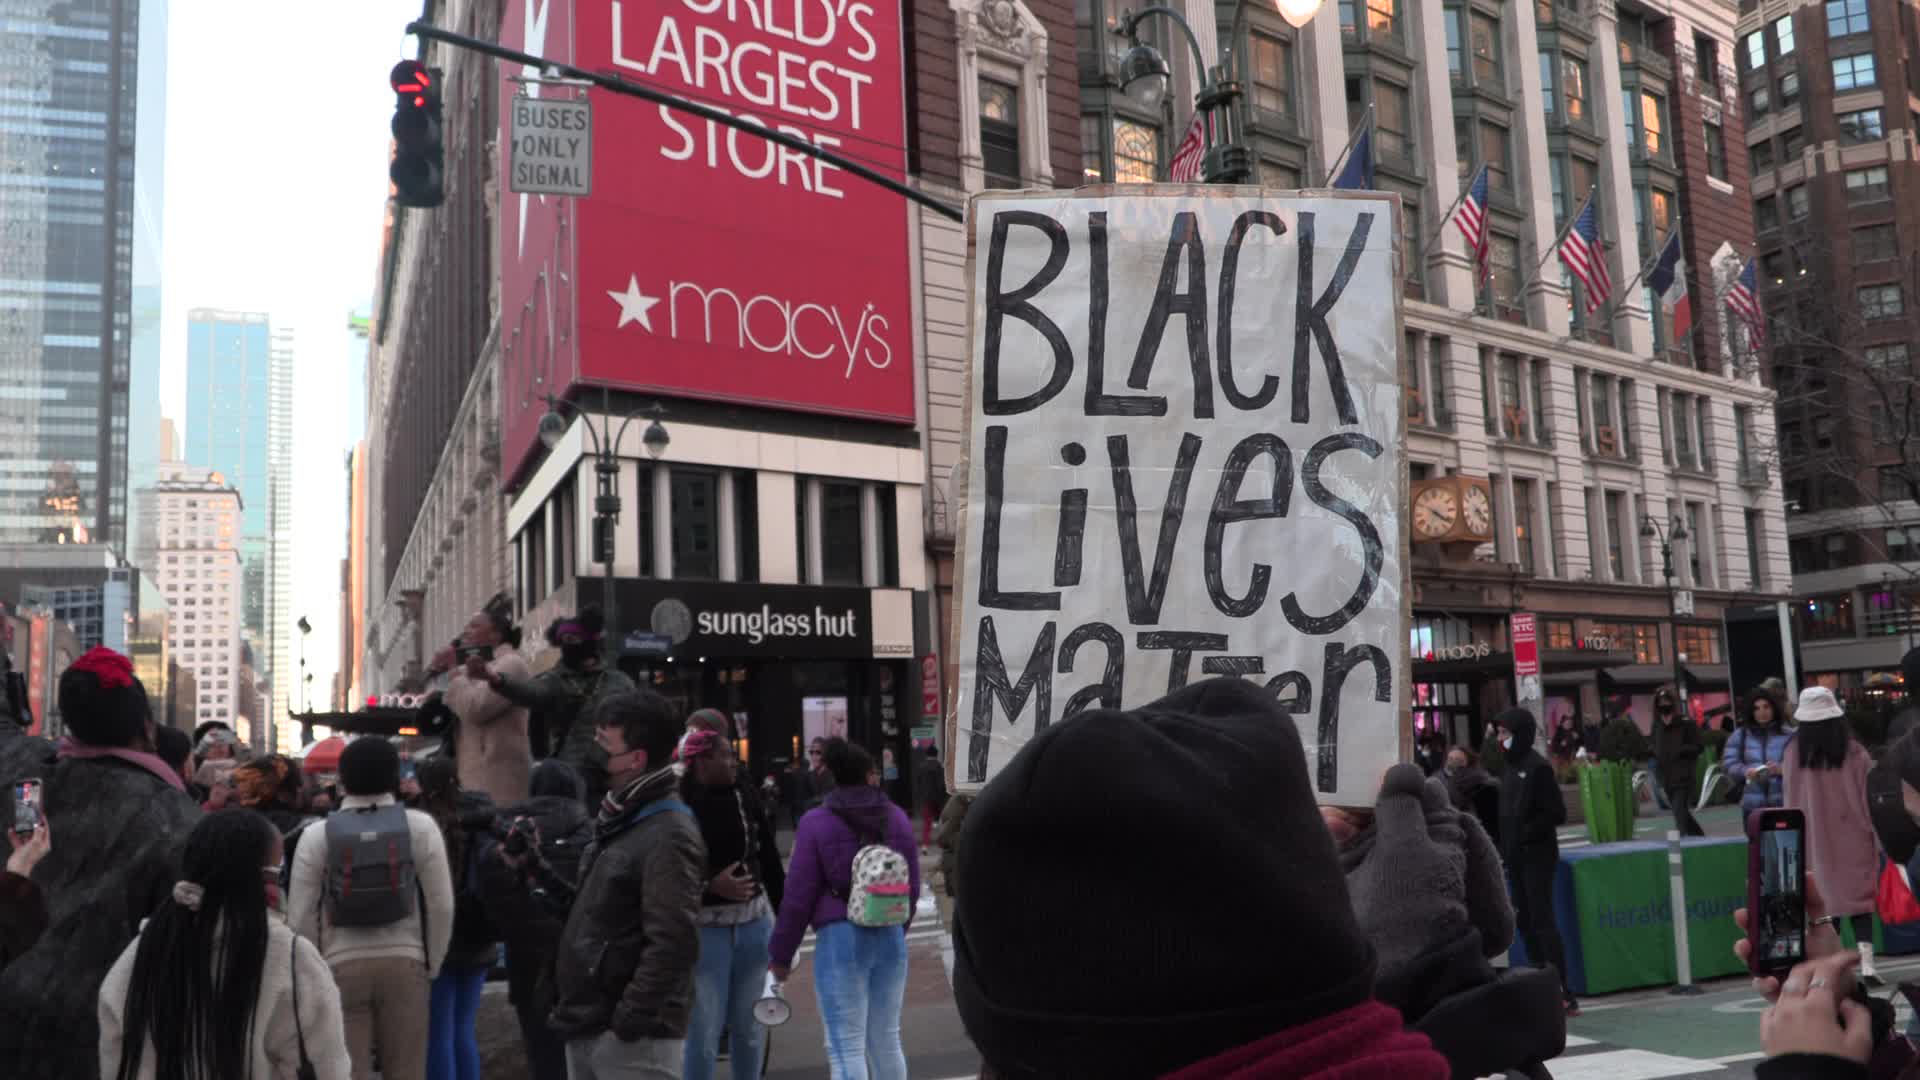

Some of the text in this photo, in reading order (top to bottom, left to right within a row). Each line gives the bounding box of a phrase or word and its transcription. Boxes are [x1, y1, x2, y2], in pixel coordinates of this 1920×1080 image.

[612, 2, 872, 129] LARGEST
[517, 106, 586, 131] BUSES
[522, 135, 580, 160] ONLY
[659, 102, 845, 198] STORE
[517, 162, 583, 188] SIGNAL
[668, 279, 892, 379] macy's
[983, 210, 1375, 425] BLACK
[697, 603, 856, 644] sunglass hut
